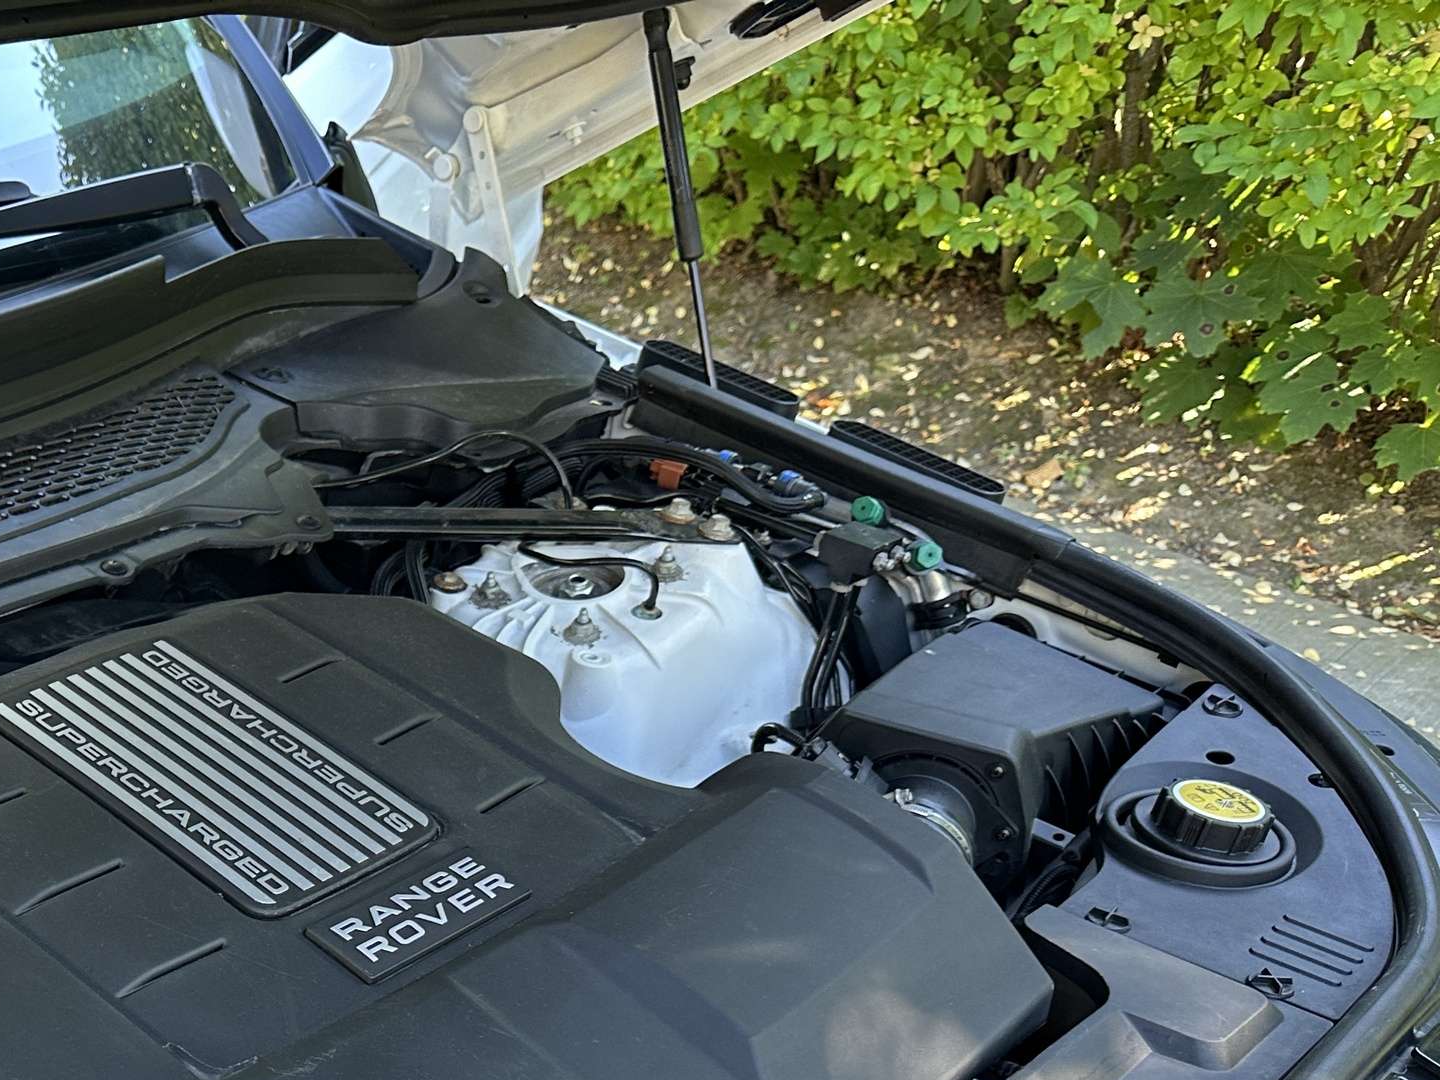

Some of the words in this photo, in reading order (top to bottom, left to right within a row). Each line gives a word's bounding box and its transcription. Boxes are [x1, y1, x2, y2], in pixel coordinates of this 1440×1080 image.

[15, 698, 290, 896] SUPERCHARGED
[142, 649, 415, 834] SUPERCHARGED
[330, 856, 488, 942] RANGE
[355, 873, 515, 964] ROVER
